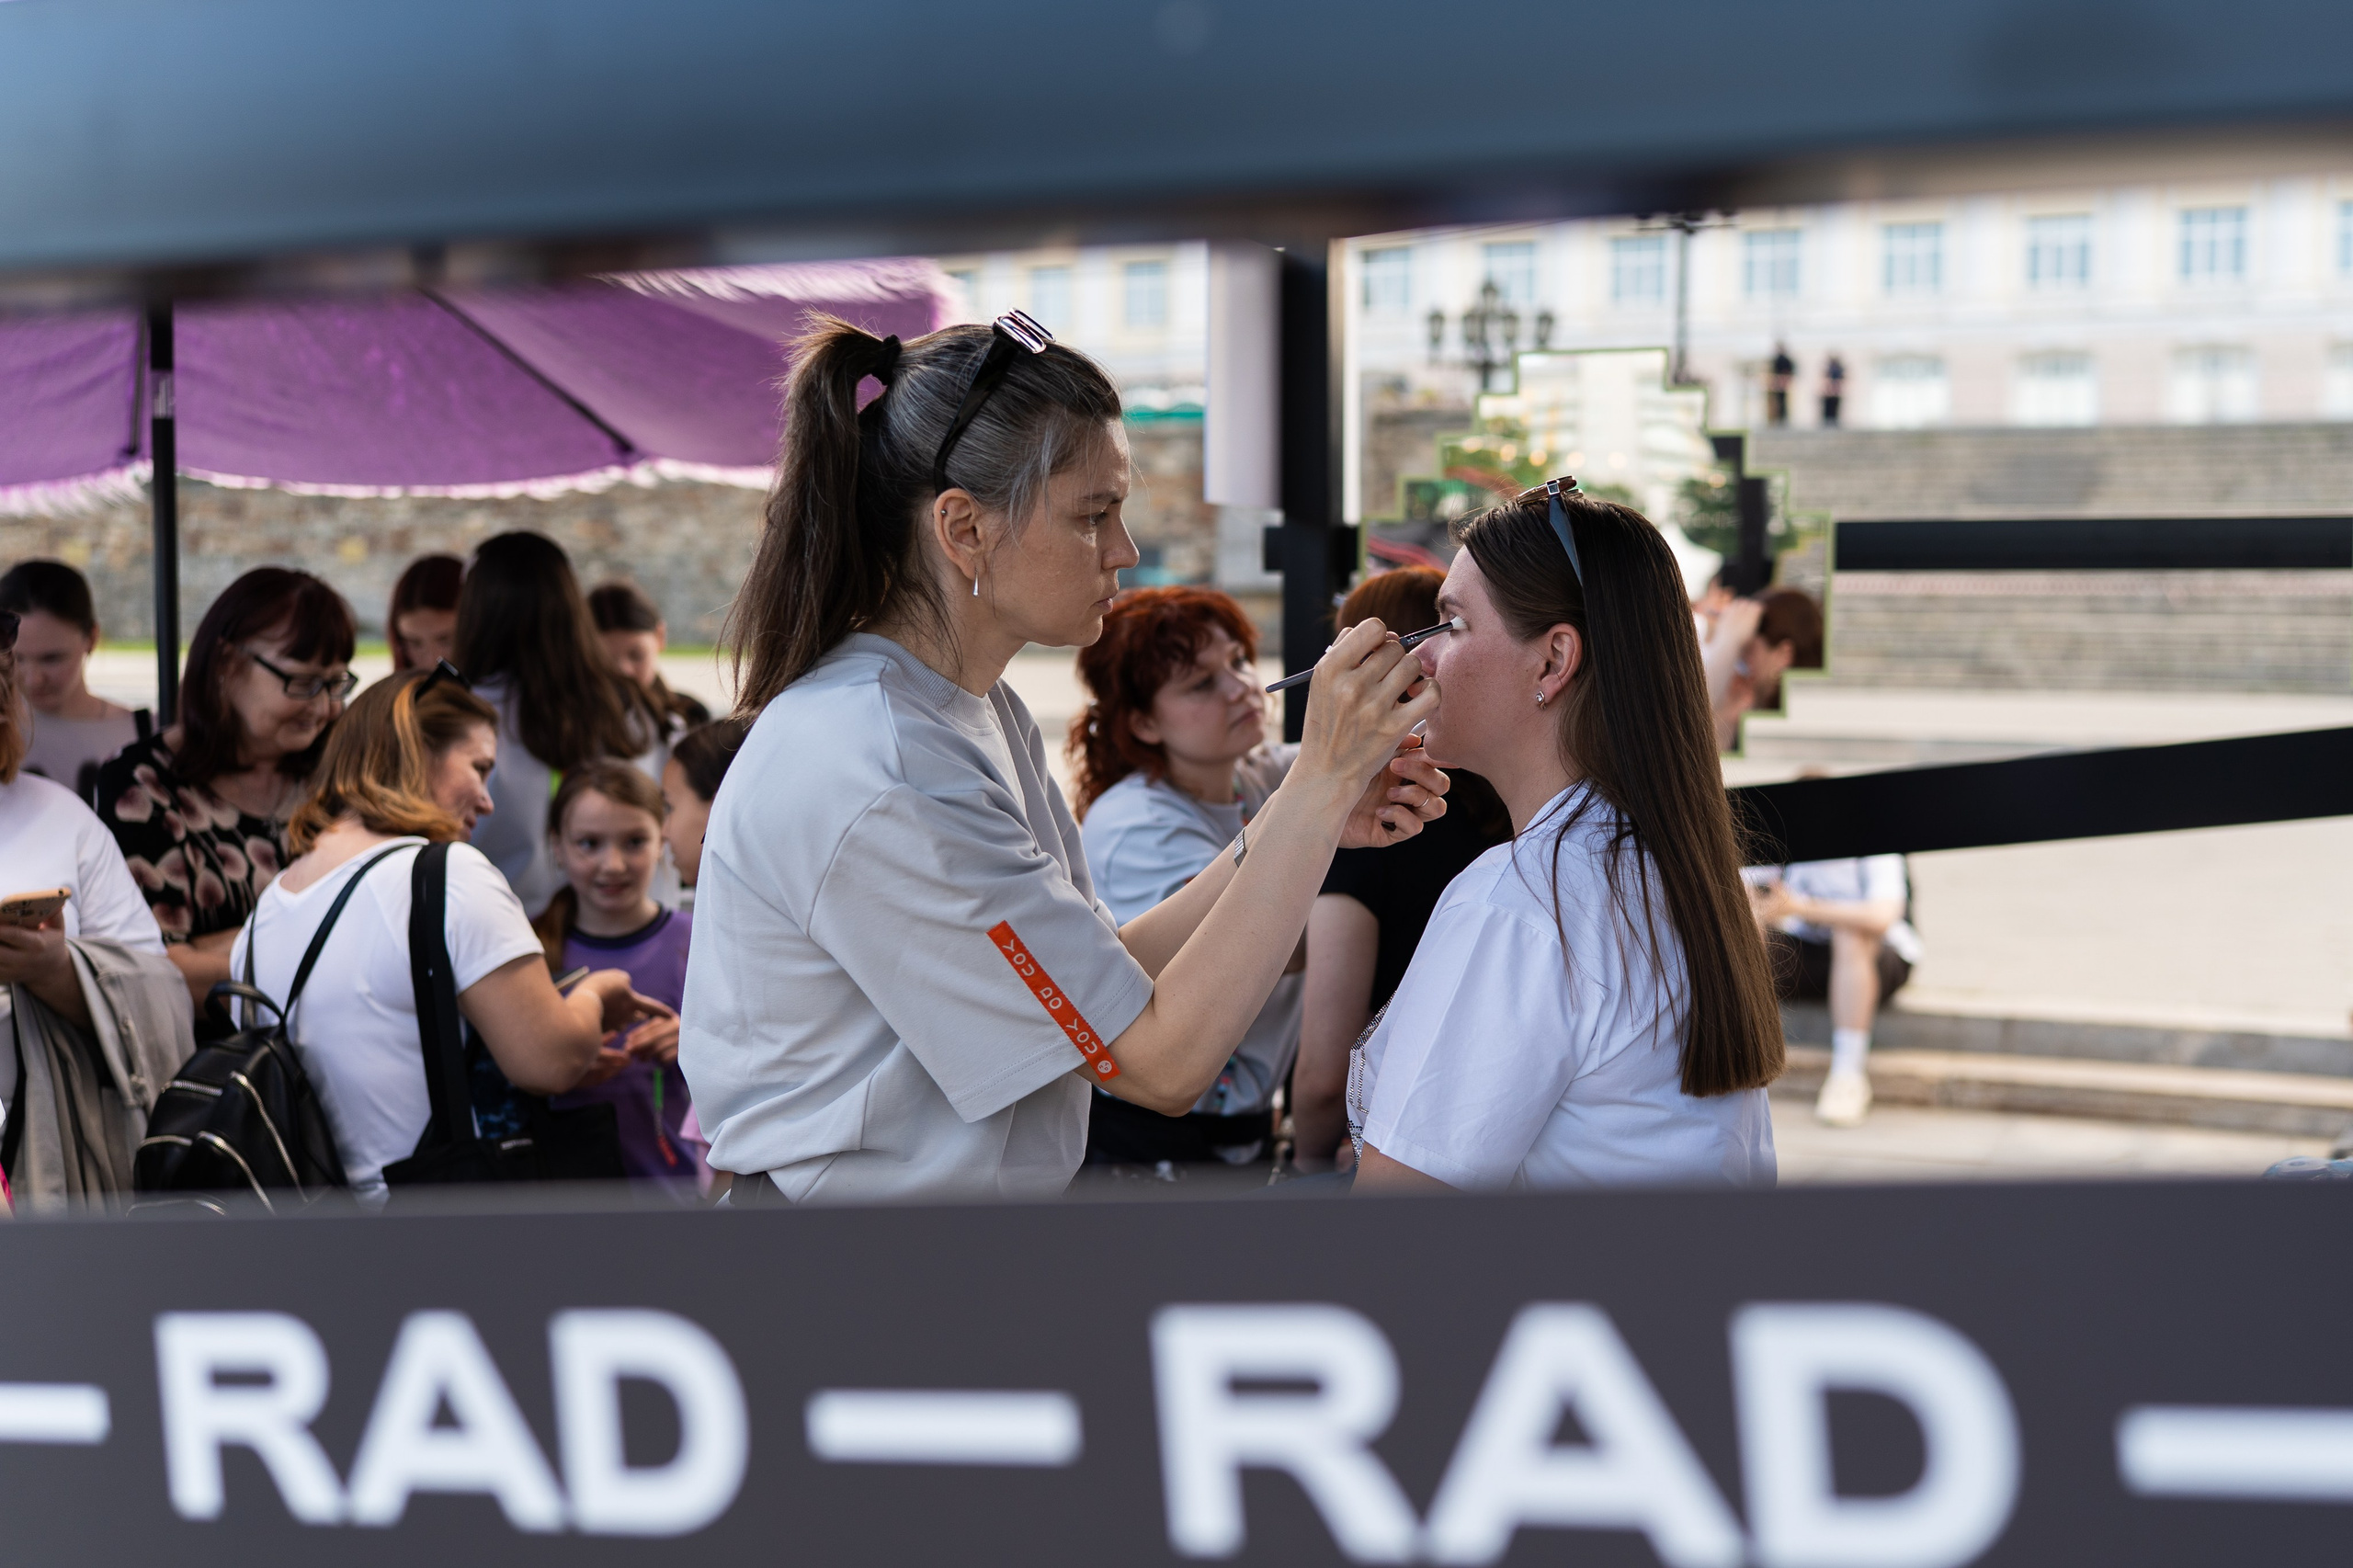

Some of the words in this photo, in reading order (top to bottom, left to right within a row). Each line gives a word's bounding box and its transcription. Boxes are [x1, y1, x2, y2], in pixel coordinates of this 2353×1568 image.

[1003, 939, 1035, 976] YOU
[1040, 987, 1062, 1010] DO
[1066, 1018, 1097, 1054] YOU
[155, 1310, 747, 1534] RAD
[1153, 1304, 2018, 1568] RAD
